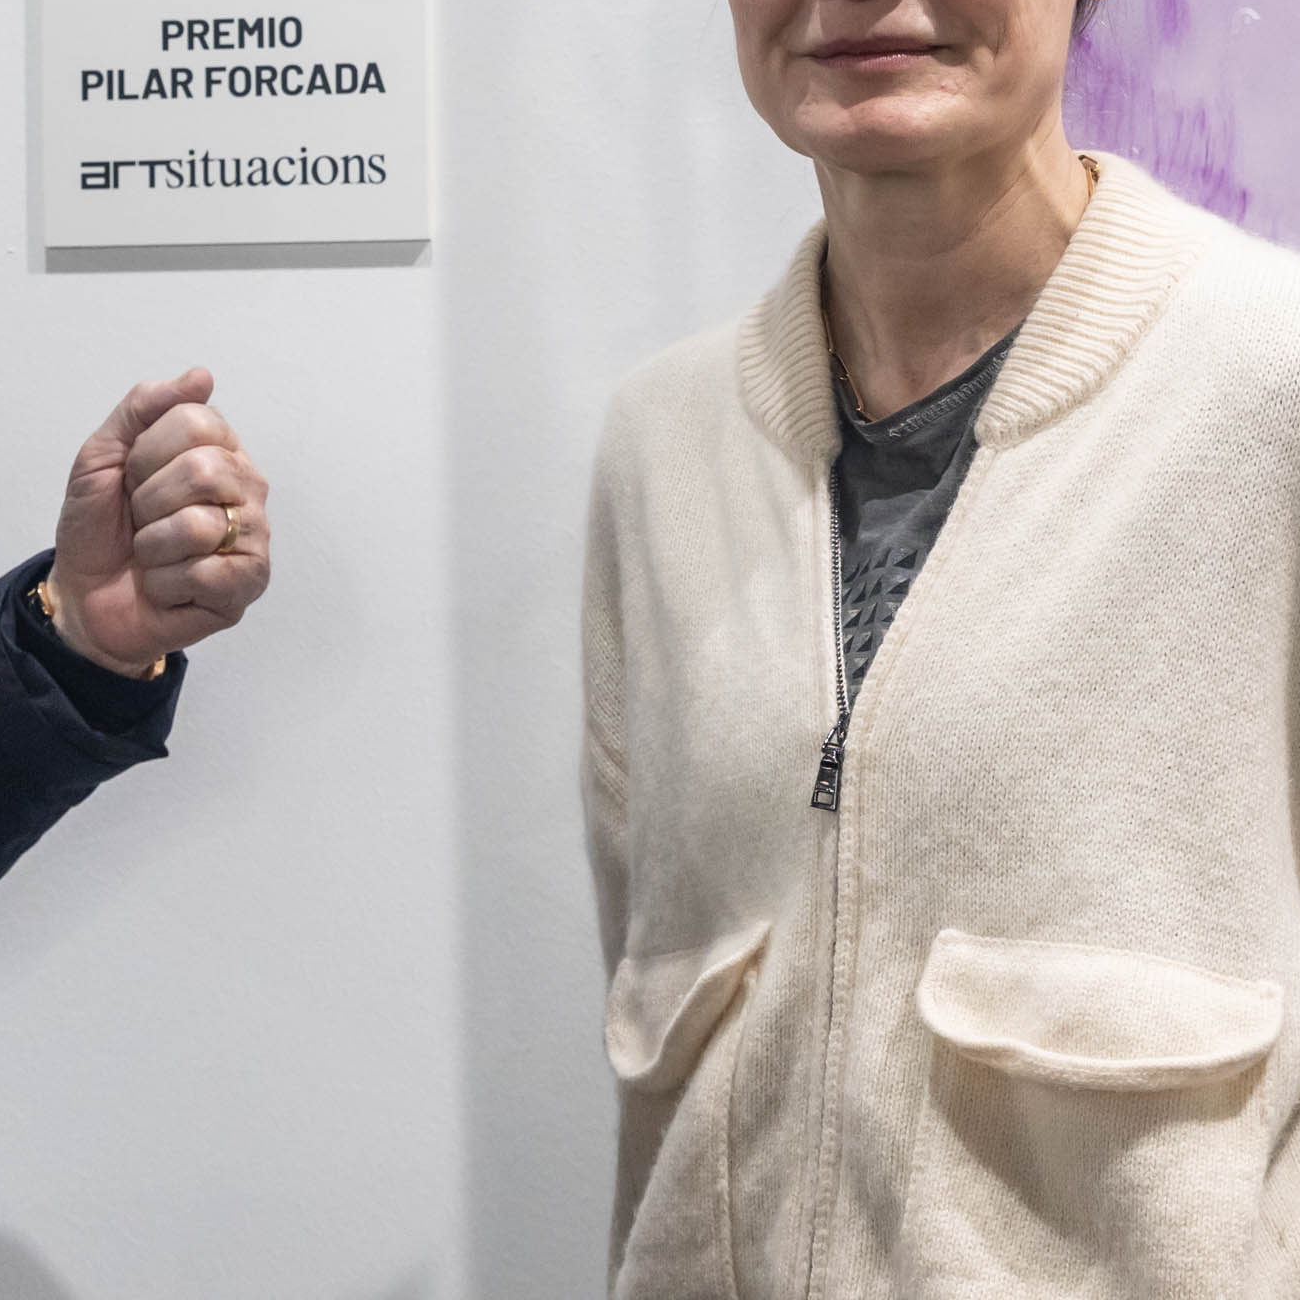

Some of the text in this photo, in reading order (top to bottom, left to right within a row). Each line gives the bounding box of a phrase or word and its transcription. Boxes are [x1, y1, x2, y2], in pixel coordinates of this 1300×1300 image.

[161, 15, 303, 51] PREMIO
[81, 62, 386, 102] PILAR FORCADA
